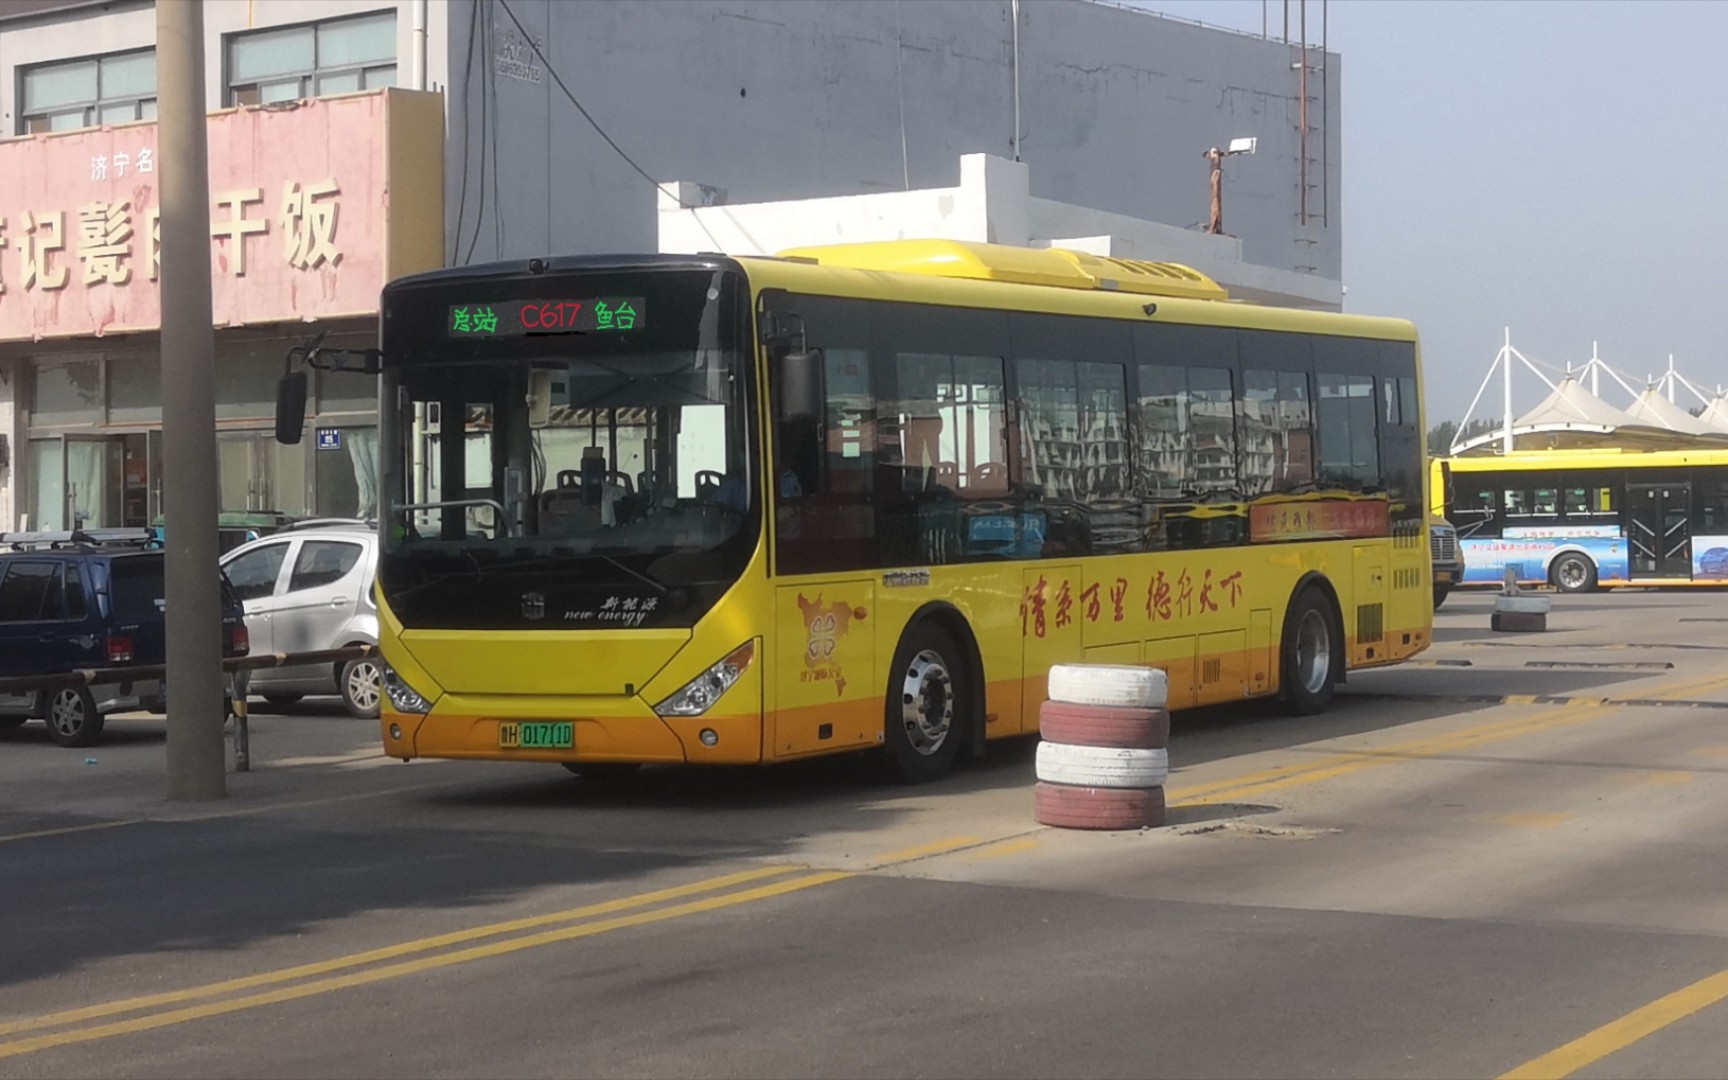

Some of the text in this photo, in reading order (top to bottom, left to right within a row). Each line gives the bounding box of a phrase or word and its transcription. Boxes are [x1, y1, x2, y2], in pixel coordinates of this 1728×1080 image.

[90, 147, 154, 181] 济宁名
[0, 178, 343, 294] 记甏干饭
[453, 306, 498, 333] 总站
[520, 303, 581, 328] C617
[595, 301, 636, 330] 鱼台
[598, 611, 646, 627] energy
